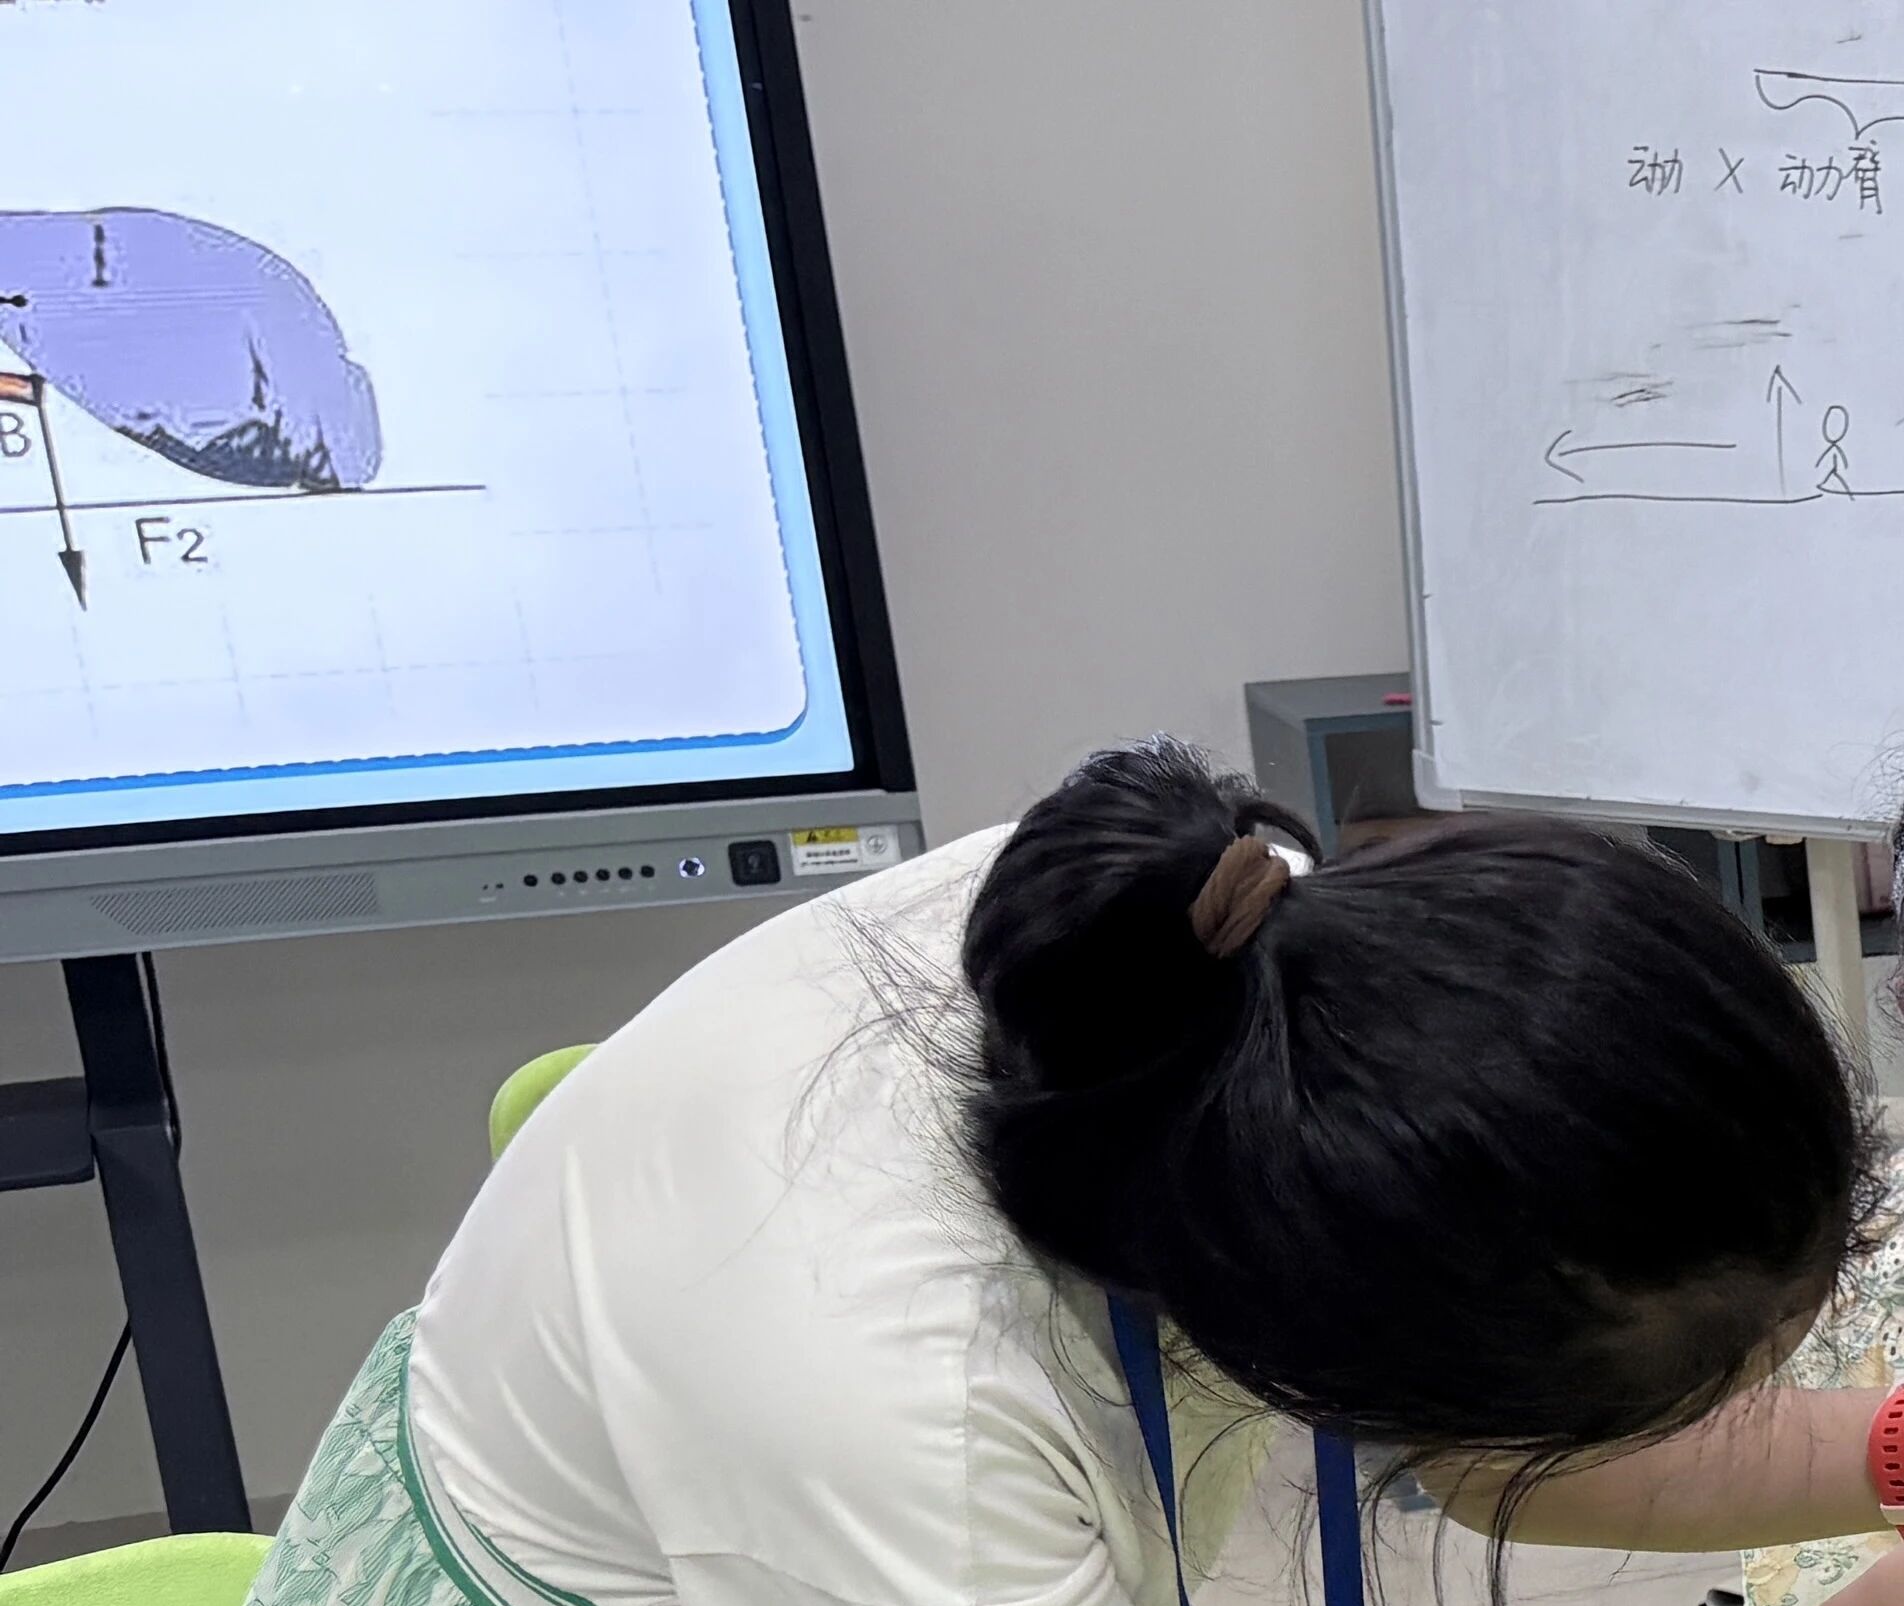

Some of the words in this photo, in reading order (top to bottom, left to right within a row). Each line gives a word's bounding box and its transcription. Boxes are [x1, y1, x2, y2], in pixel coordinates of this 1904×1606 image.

[1778, 139, 1884, 215] 动力臂
[135, 517, 208, 566] F2
